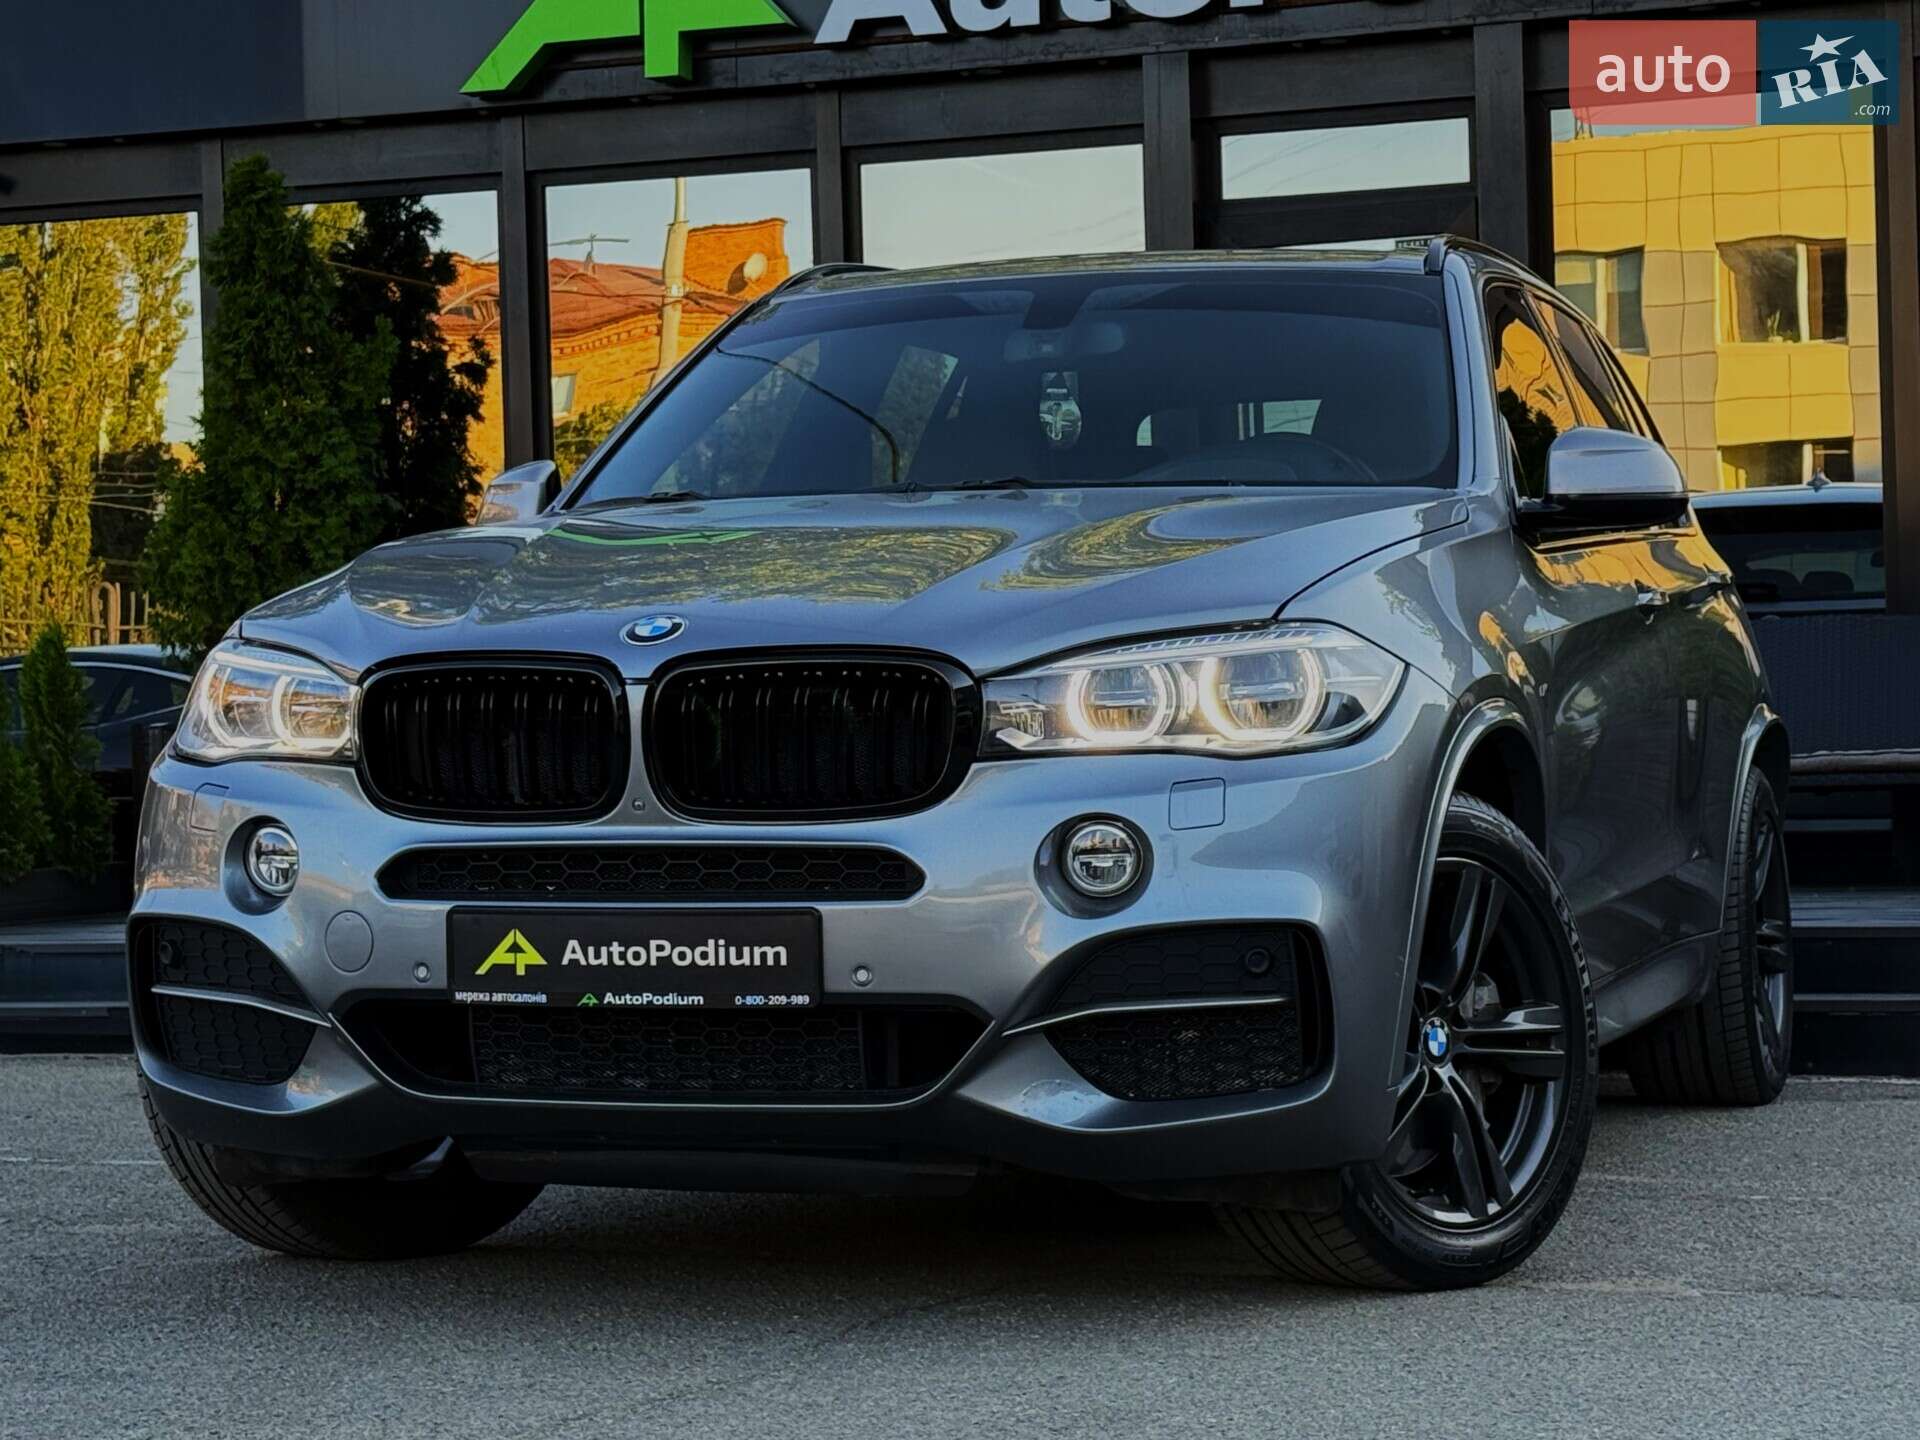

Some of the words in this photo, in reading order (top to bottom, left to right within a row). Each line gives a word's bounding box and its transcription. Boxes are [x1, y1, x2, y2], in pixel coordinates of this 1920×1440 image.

[561, 939, 788, 967] AutoPodium
[603, 992, 704, 1006] AutoPodium
[734, 994, 810, 1006] 0-800-209-989
